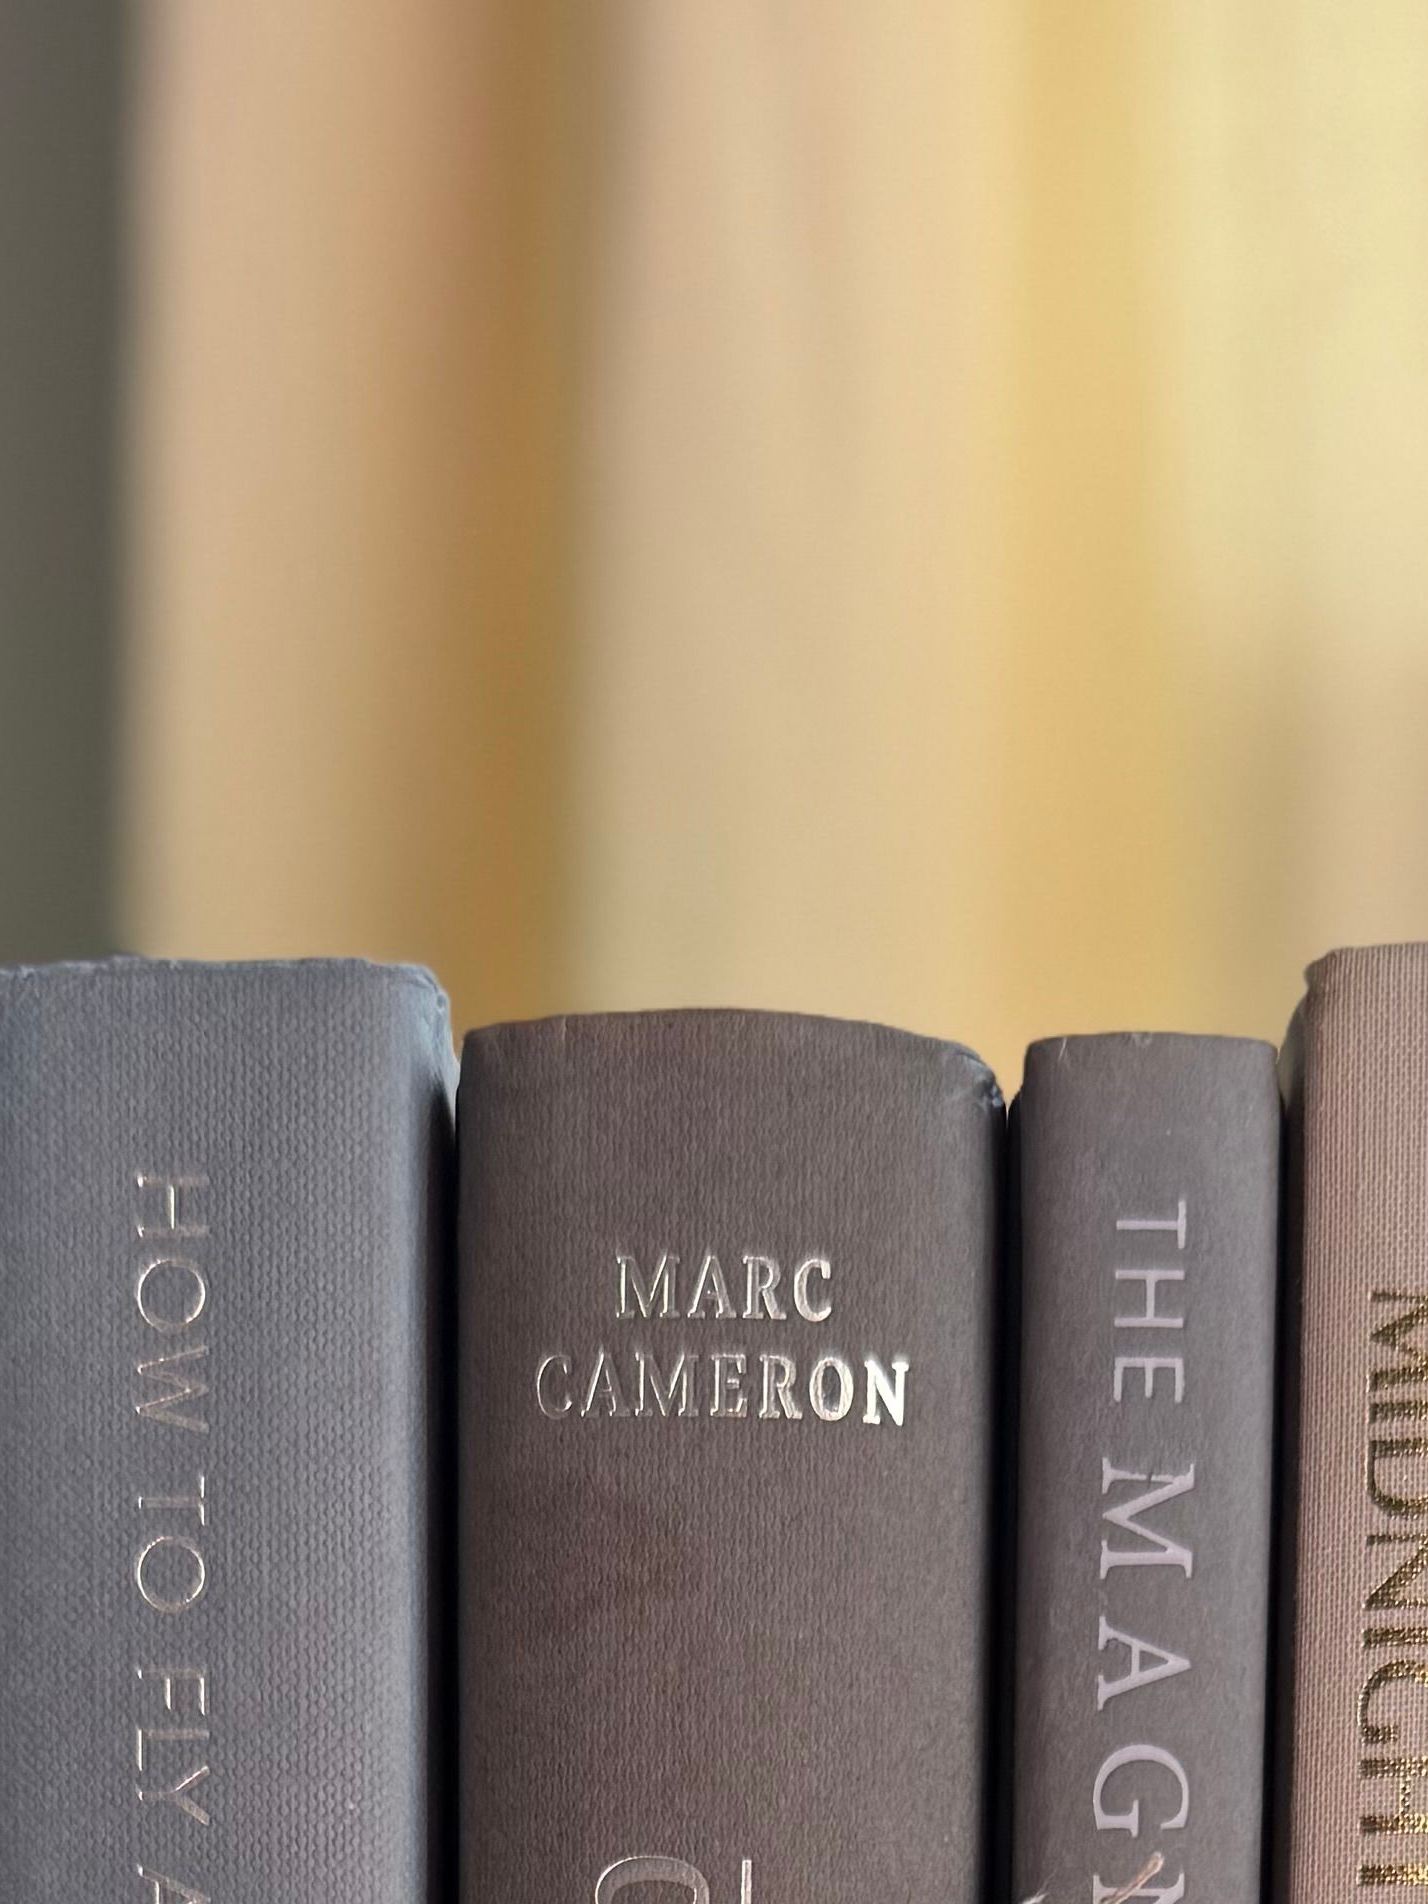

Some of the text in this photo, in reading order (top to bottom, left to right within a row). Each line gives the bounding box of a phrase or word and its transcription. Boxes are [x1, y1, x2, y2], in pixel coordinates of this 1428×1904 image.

[135, 1173, 210, 1433] HOW
[616, 1253, 833, 1322] MARC
[1113, 1201, 1188, 1403] THE
[536, 1351, 910, 1427] CAMERON
[135, 1475, 206, 1614] TO
[135, 1667, 210, 1826] FLY
